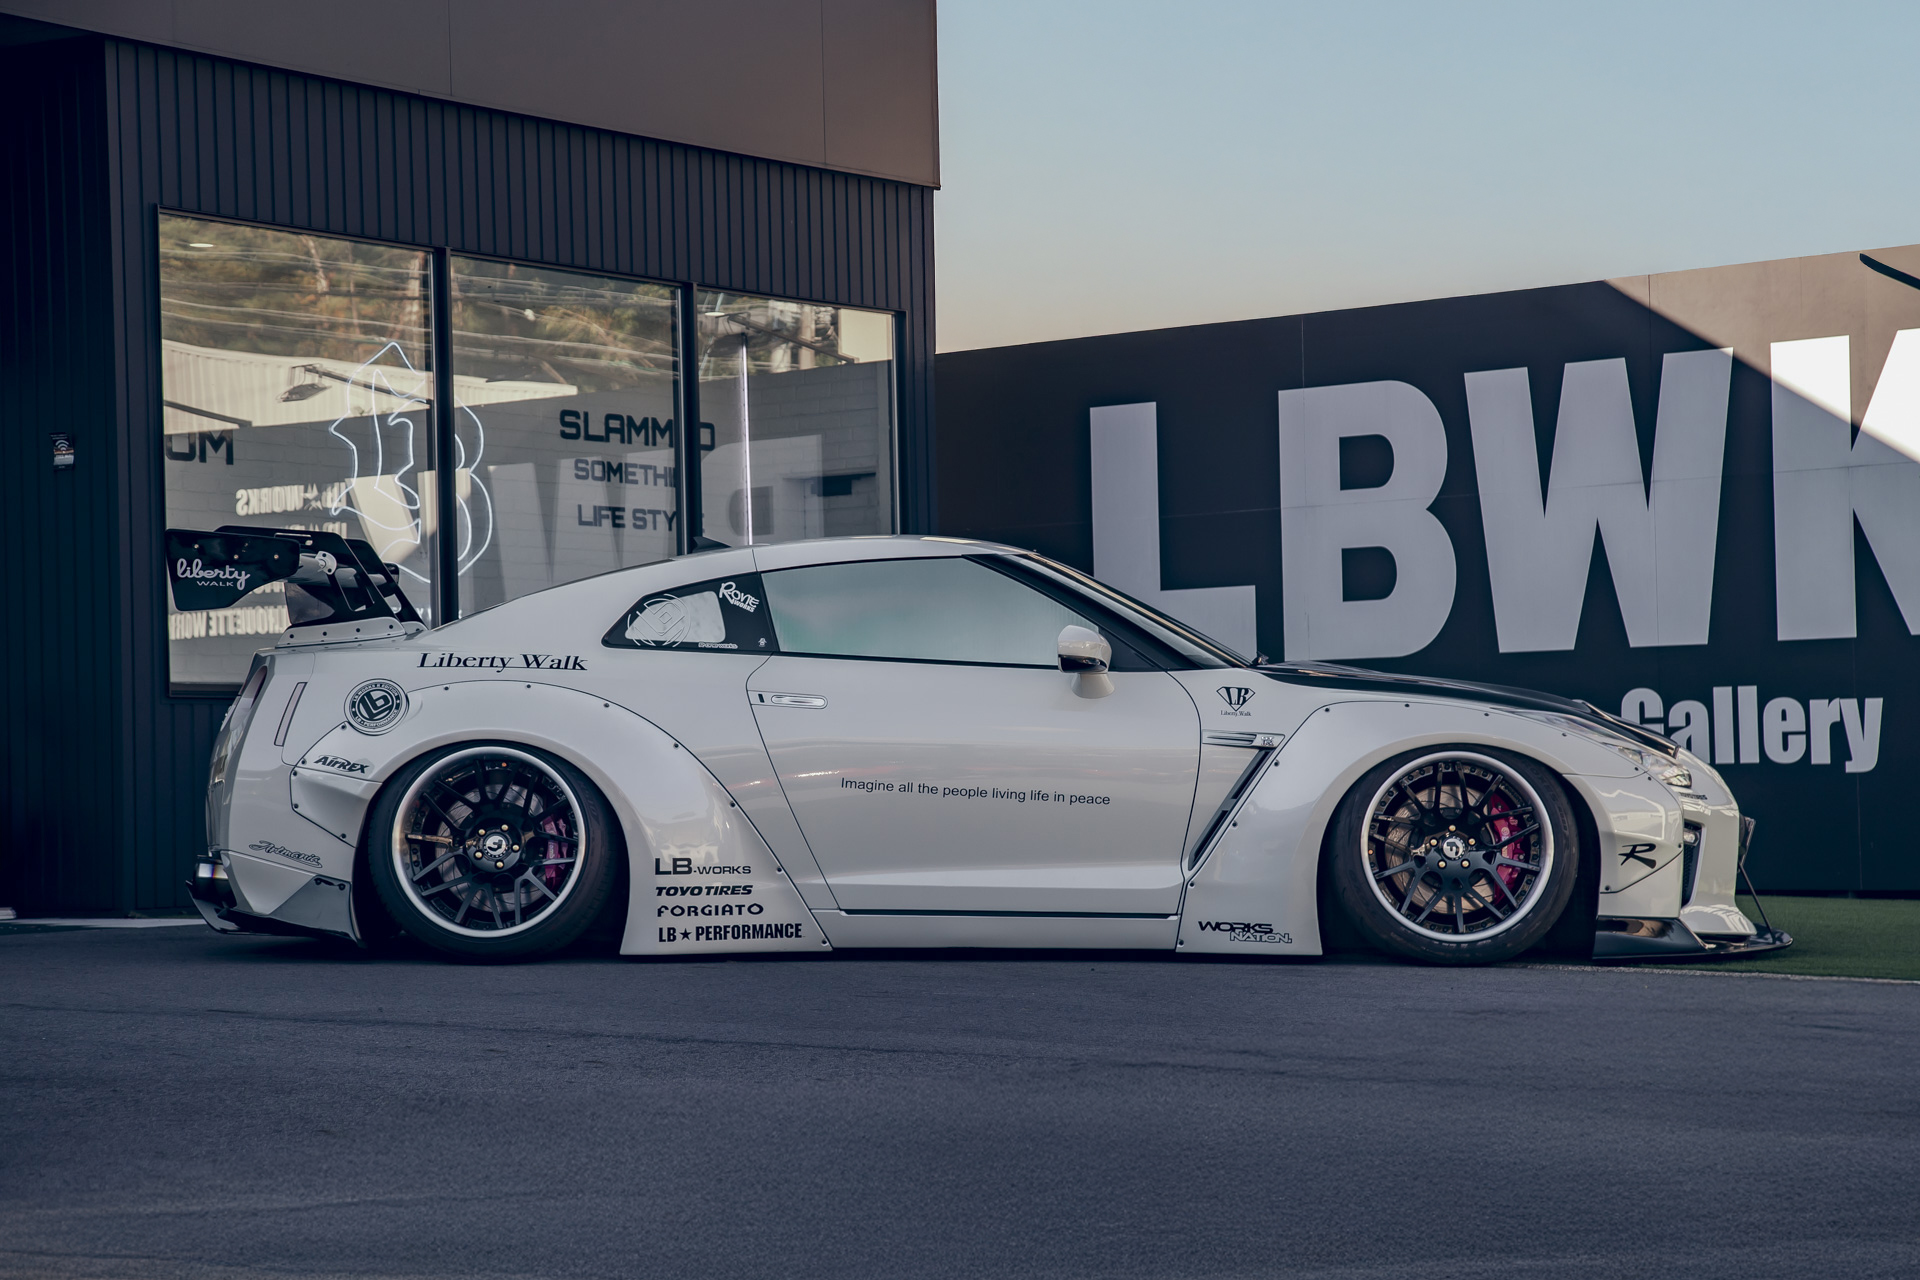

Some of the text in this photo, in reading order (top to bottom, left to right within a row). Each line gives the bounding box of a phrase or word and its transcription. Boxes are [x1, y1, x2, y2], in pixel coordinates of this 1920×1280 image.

[559, 409, 716, 452] SLAMMD
[574, 458, 676, 488] SOMETHI
[1090, 328, 1920, 662] LBWK
[577, 504, 678, 532] LIFE STY
[176, 558, 251, 591] liberty
[417, 653, 588, 673] Liberty Walk
[1621, 685, 1883, 774] Gallery
[841, 777, 1111, 806] Imagine all the people living life in peace
[655, 884, 754, 897] TOYO TIRES
[657, 903, 764, 917] FORGIATO
[658, 923, 803, 943] LB PERFORMANCE
[1198, 921, 1274, 934] WORKS
